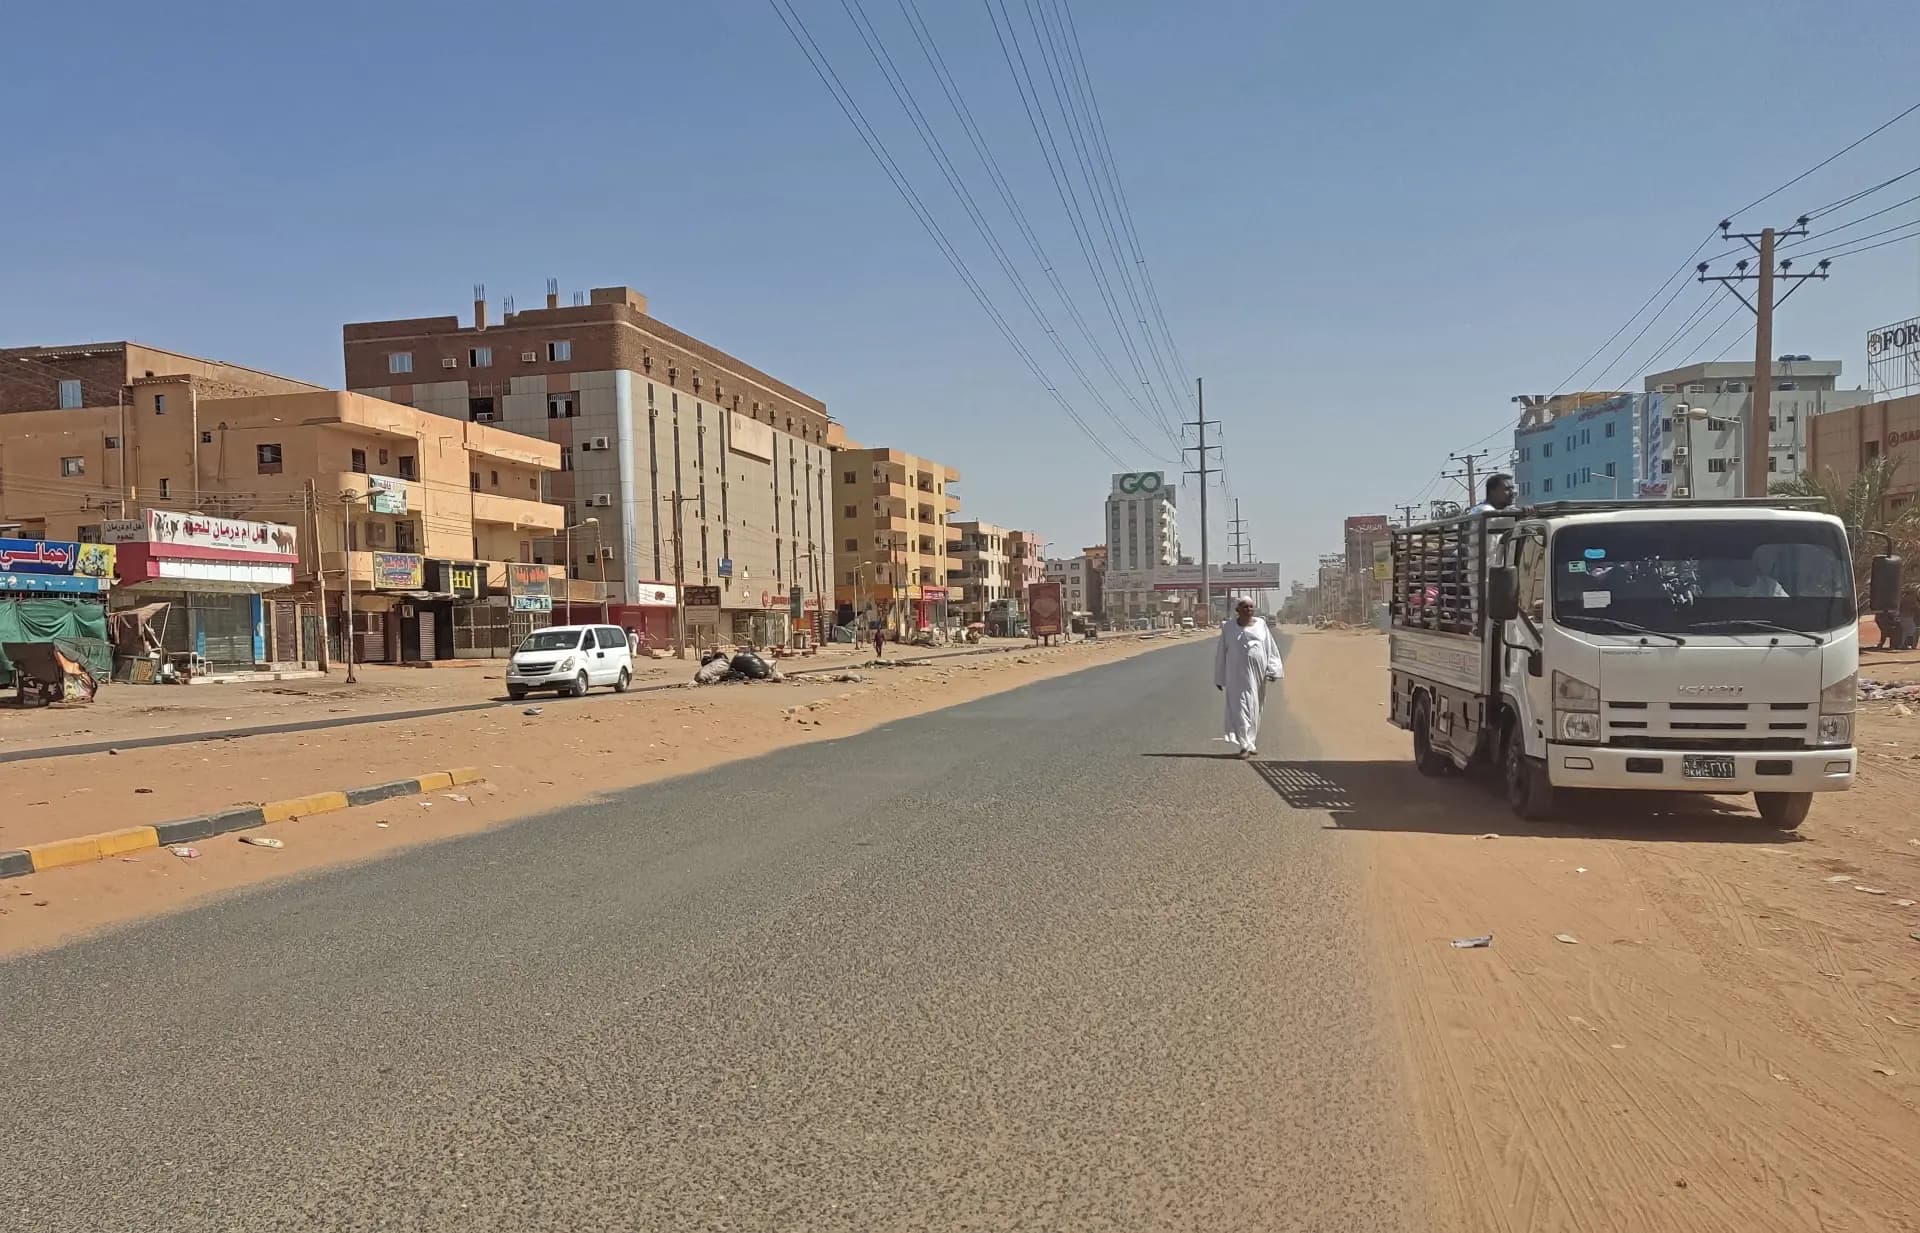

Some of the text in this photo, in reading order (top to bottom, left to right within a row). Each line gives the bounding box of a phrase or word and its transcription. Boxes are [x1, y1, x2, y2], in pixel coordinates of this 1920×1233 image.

[1882, 324, 1920, 351] FOR
[1119, 472, 1161, 495] GO
[213, 520, 239, 540] درمان
[1679, 685, 1744, 697] ISUZU
